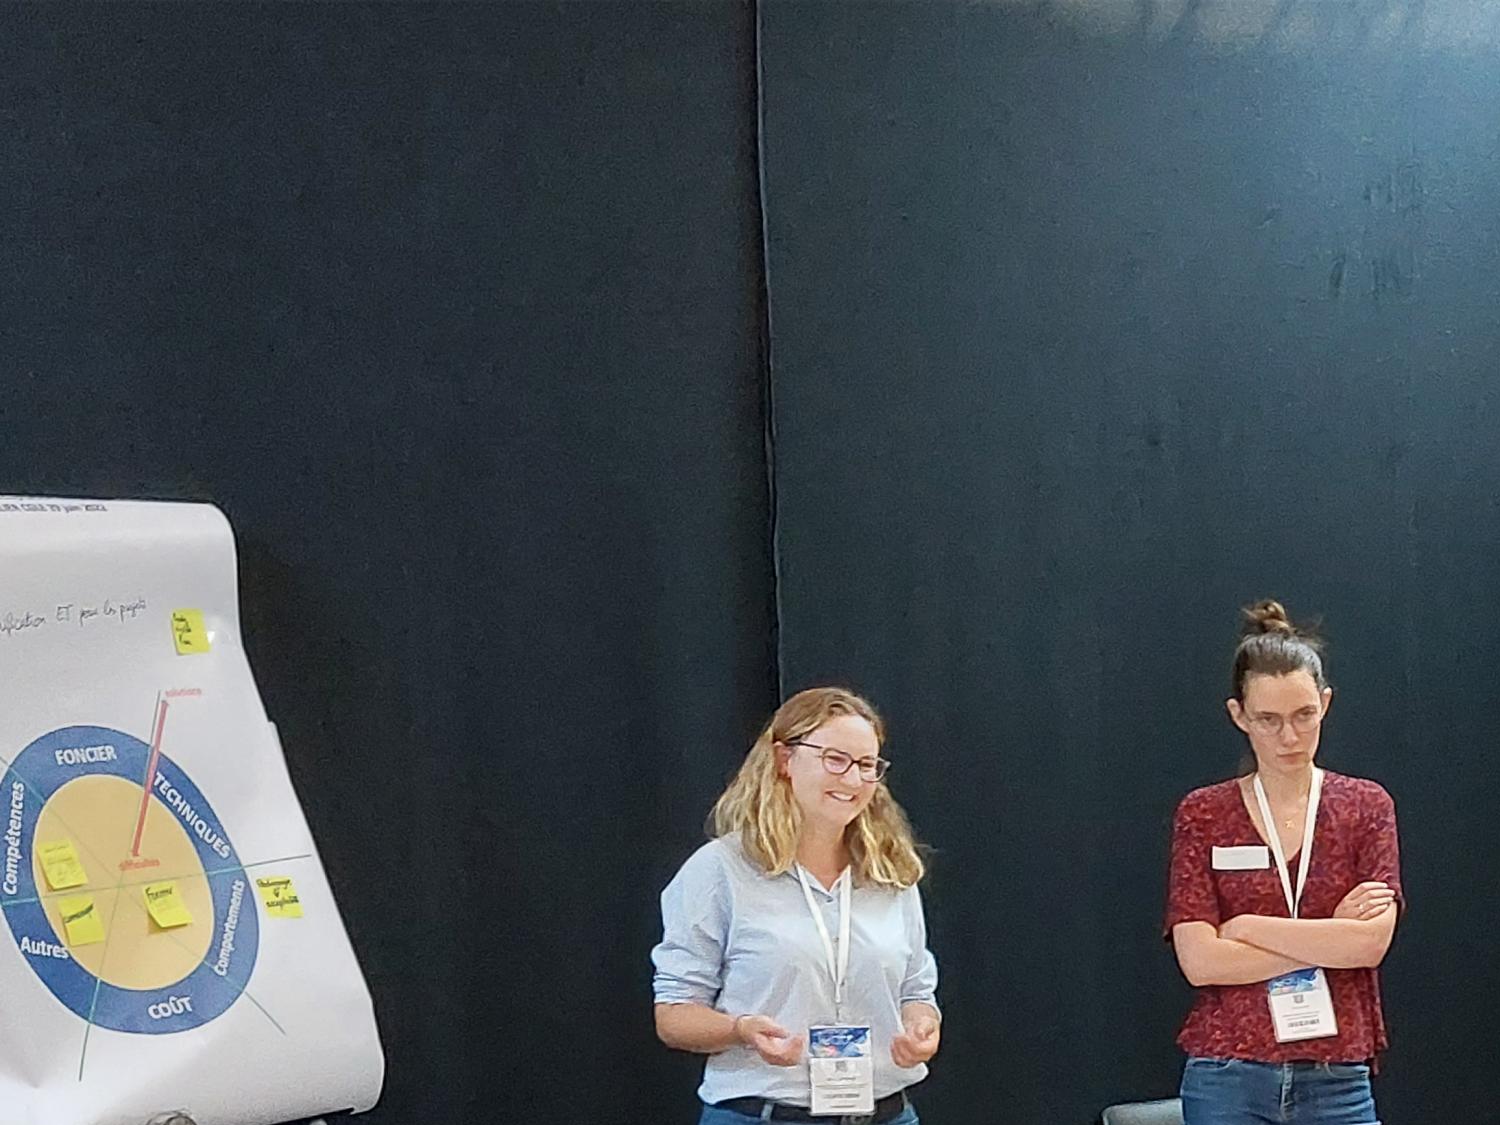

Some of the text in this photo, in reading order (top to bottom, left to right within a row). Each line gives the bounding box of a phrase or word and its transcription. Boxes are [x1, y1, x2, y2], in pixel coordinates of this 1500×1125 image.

[55, 745, 118, 767] FONCIER
[2, 781, 26, 895] Compétences
[154, 771, 231, 860] TECHNIQUES
[19, 935, 69, 960] Autres
[213, 879, 245, 978] Comportements
[147, 994, 193, 1021] COÛT
